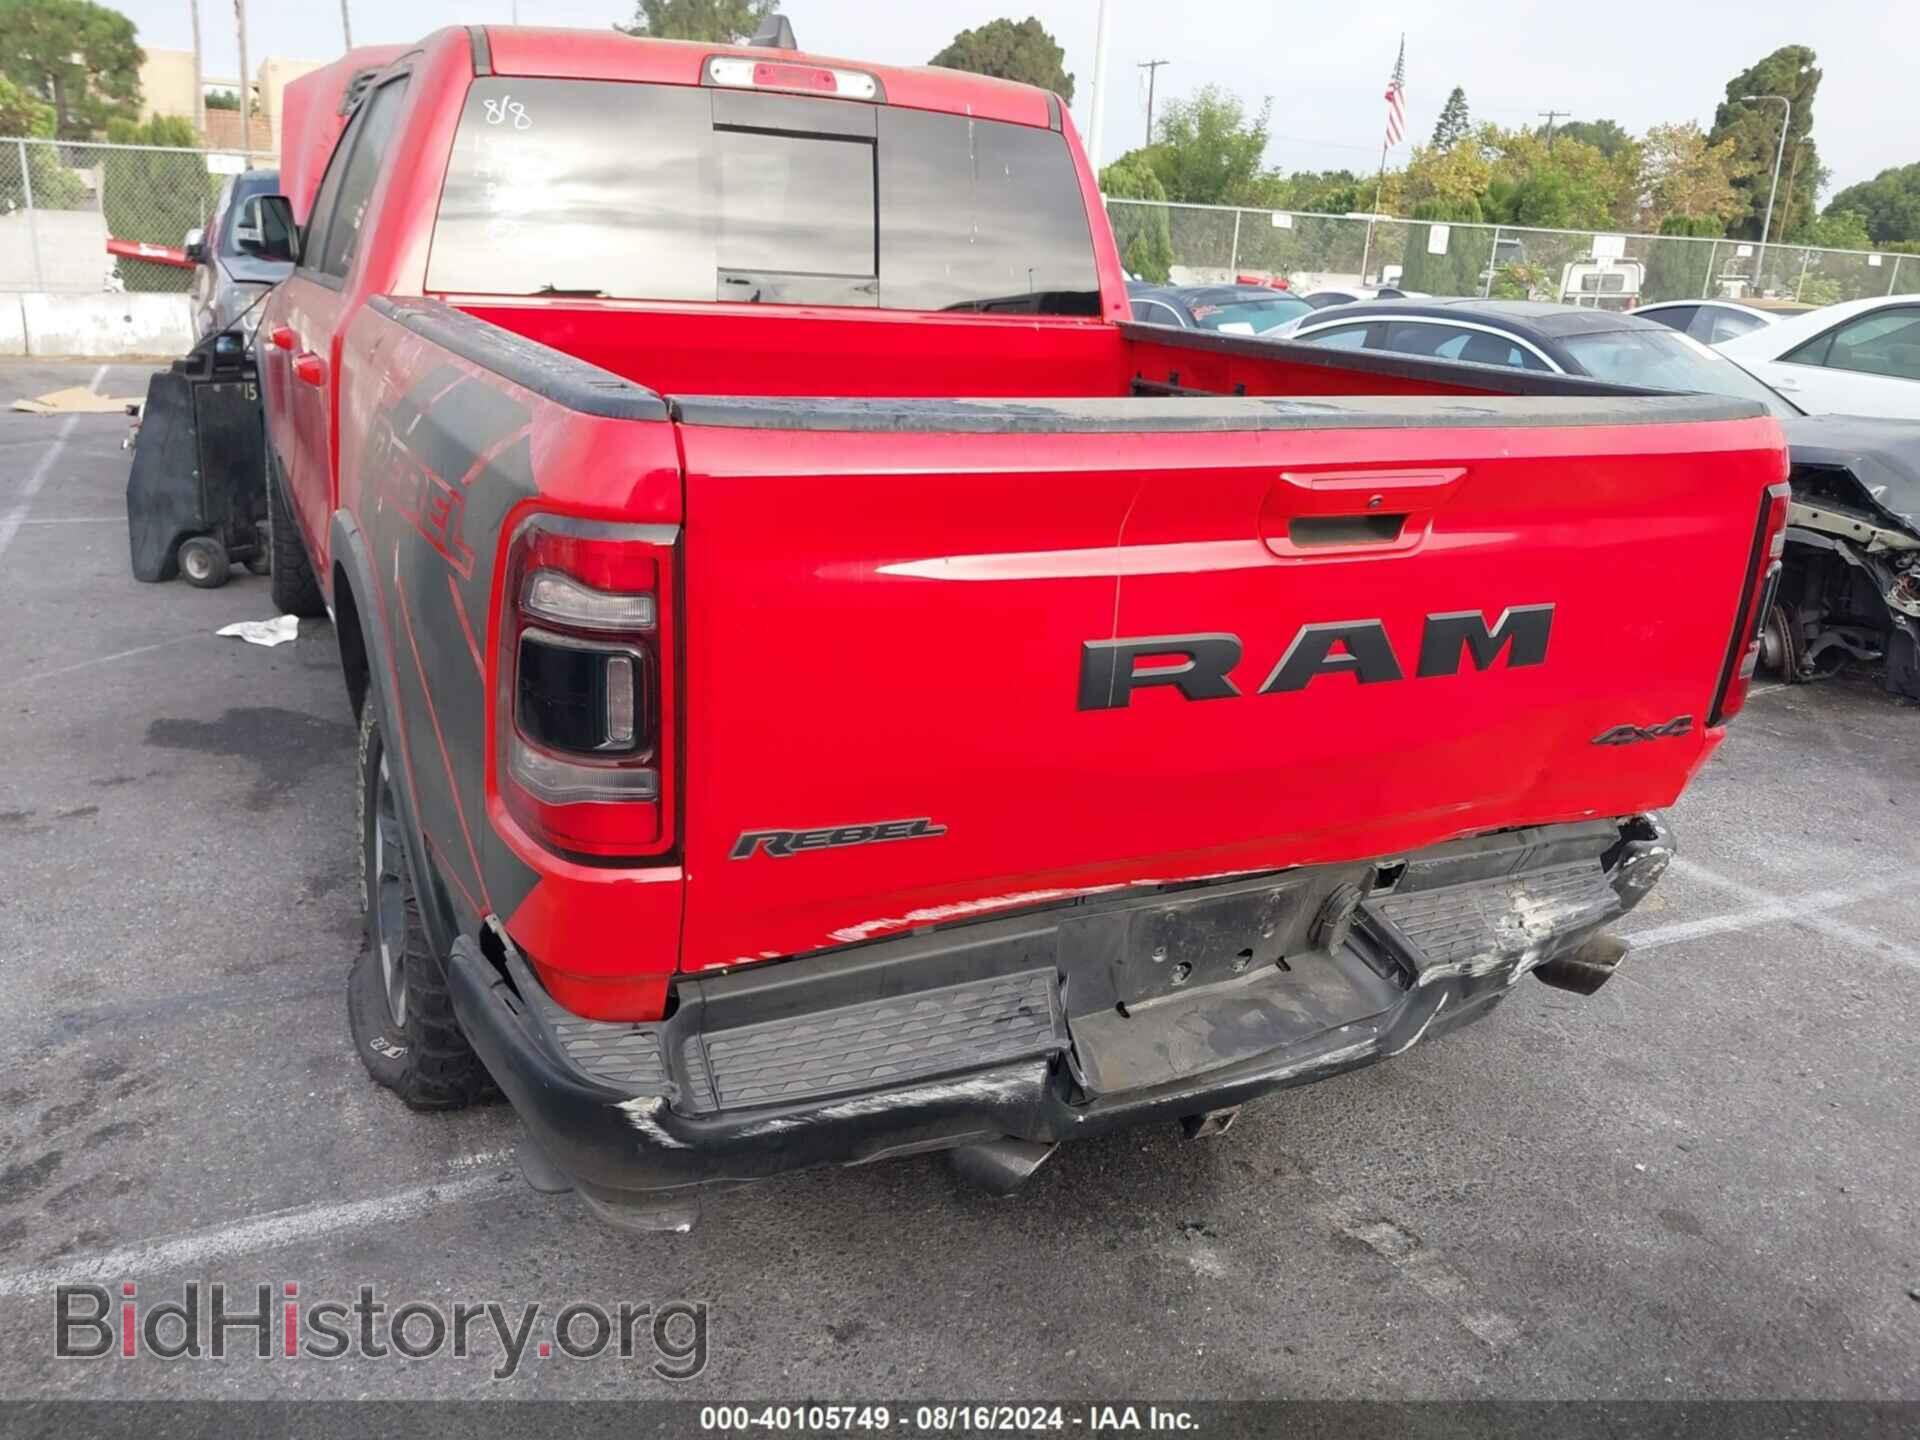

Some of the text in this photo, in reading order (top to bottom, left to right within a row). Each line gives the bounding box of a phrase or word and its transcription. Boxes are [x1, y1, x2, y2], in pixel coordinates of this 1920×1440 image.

[483, 95, 533, 130] 8/8
[1077, 603, 1556, 712] RAM
[729, 816, 948, 860] REBEL
